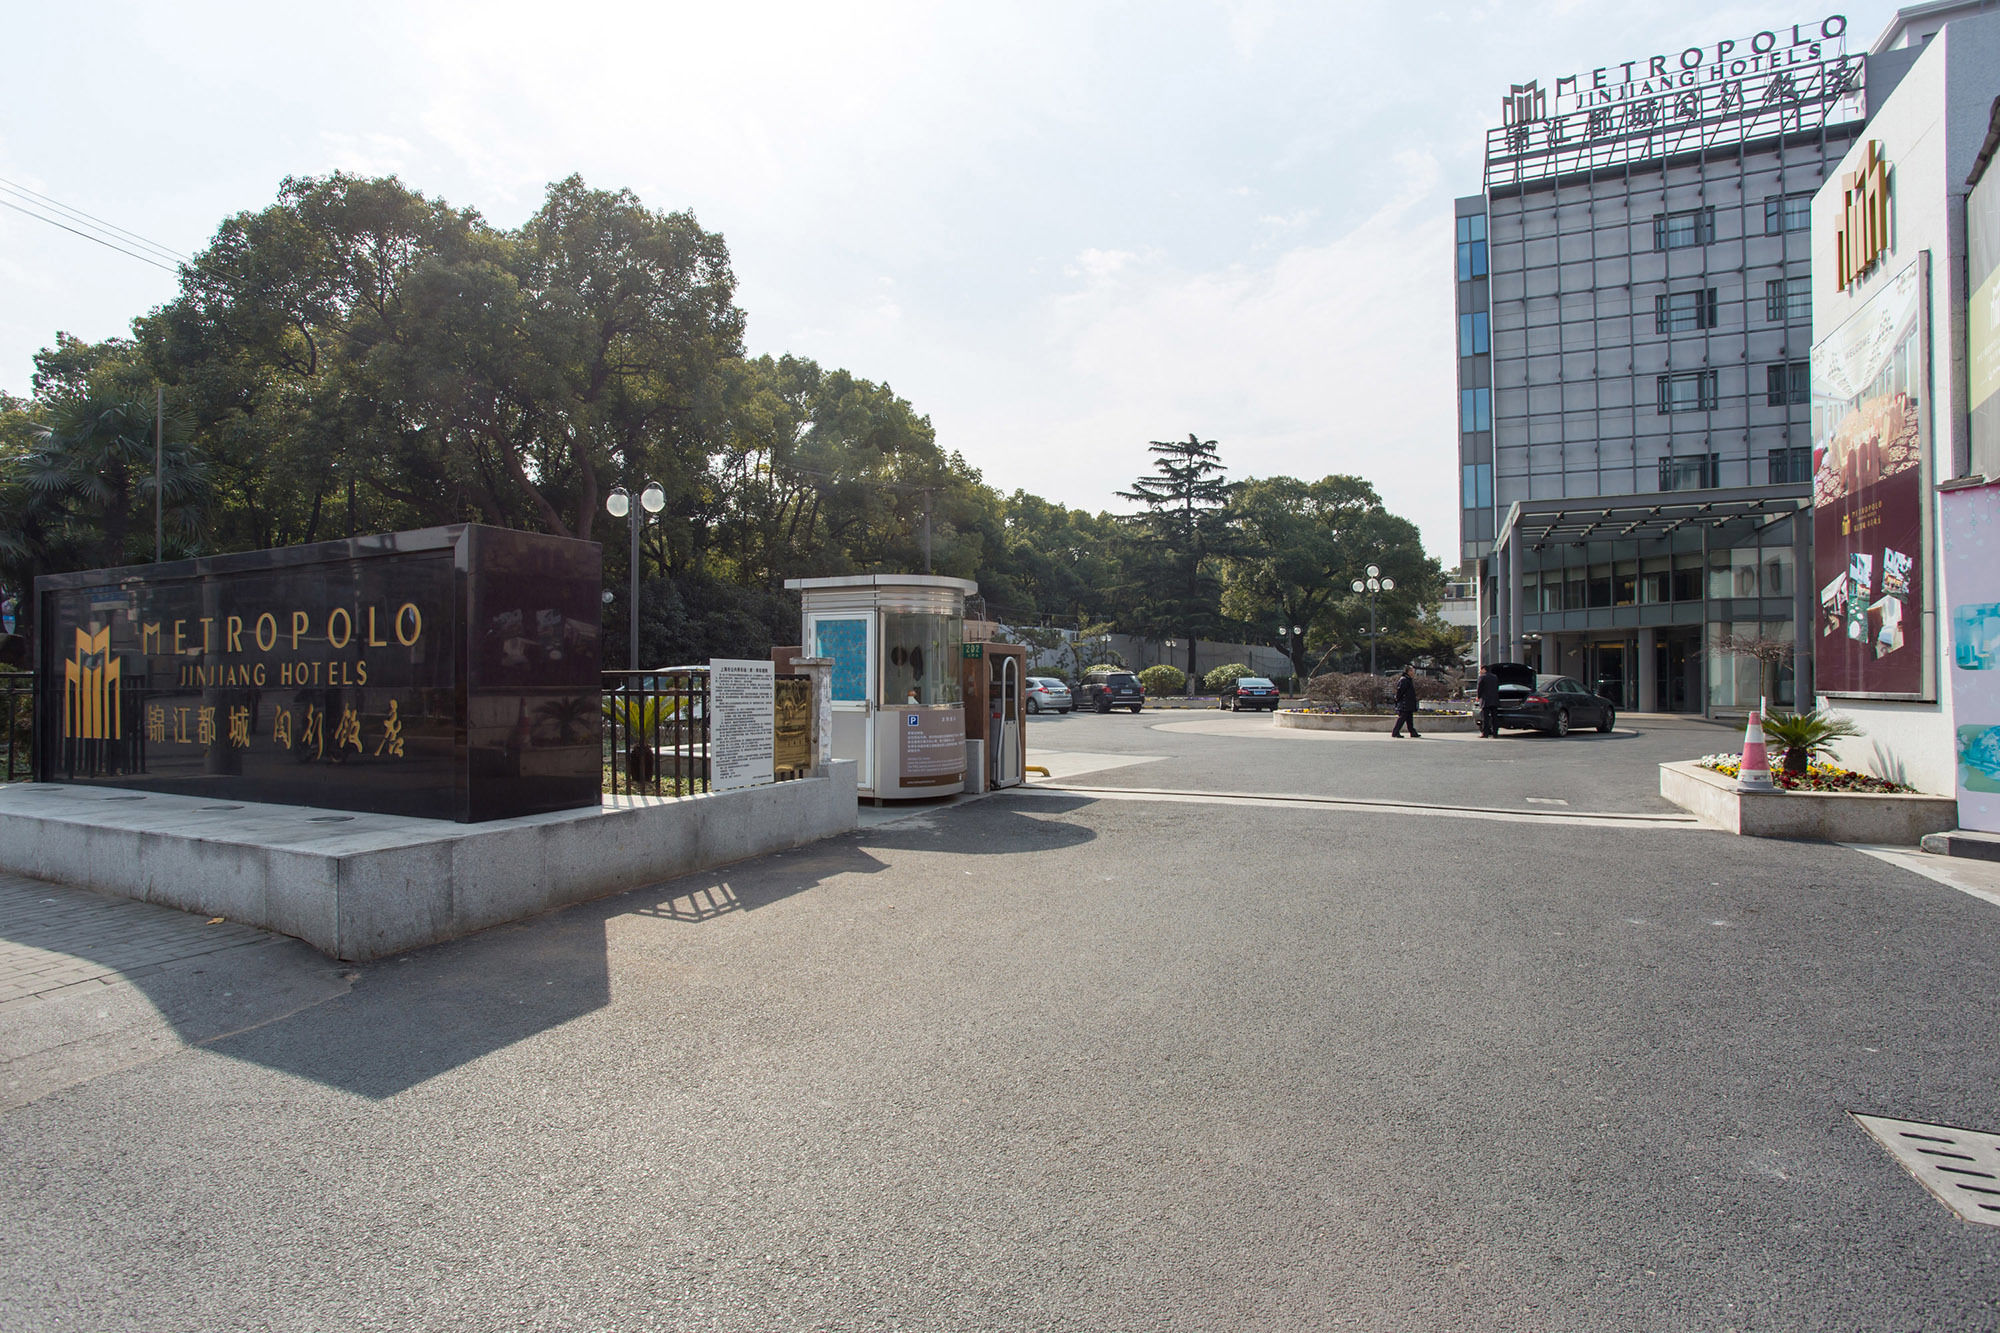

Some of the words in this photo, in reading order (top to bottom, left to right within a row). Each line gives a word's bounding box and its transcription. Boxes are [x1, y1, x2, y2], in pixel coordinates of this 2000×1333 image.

[1556, 14, 1847, 97] METROPOLO
[1577, 70, 1695, 108] JINJIANG
[1711, 42, 1821, 81] HOTELS
[143, 603, 422, 656] METROPOLO
[181, 663, 266, 687] JINJIANG
[281, 660, 368, 686] HOTELS
